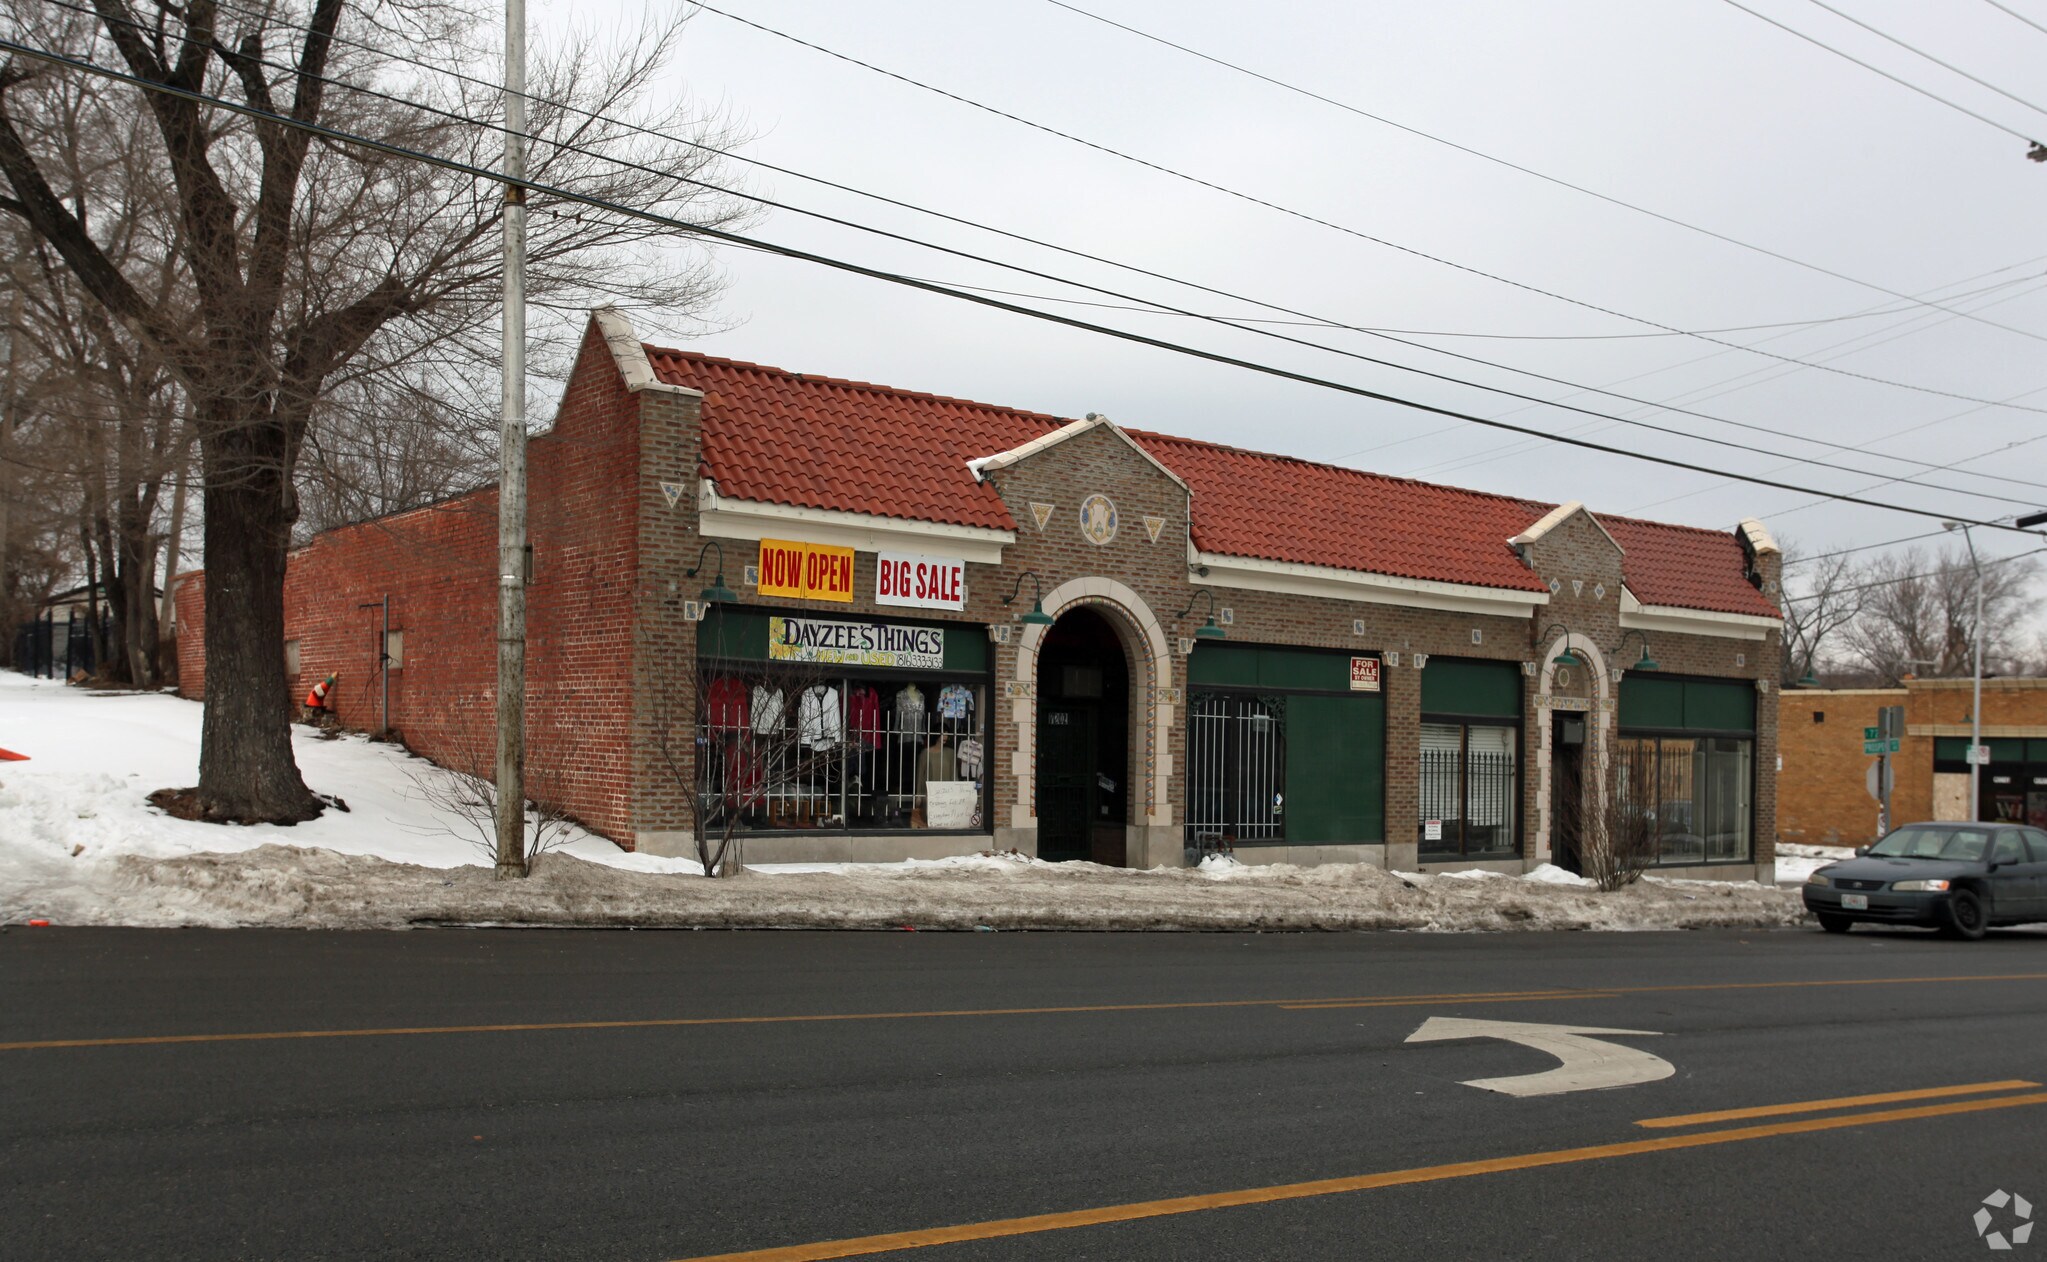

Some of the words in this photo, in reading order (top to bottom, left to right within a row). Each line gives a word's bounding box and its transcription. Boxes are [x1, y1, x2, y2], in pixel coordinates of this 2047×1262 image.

[762, 548, 803, 588] NOW
[807, 552, 851, 593] OPEN
[880, 560, 911, 598] BIG
[916, 563, 961, 602] SALE
[783, 618, 874, 651] DAYZEE'S
[871, 624, 942, 655] THINGS
[816, 650, 845, 664] NEW
[861, 651, 895, 666] USED
[1356, 660, 1373, 668] FOR
[1353, 667, 1377, 677] SALE
